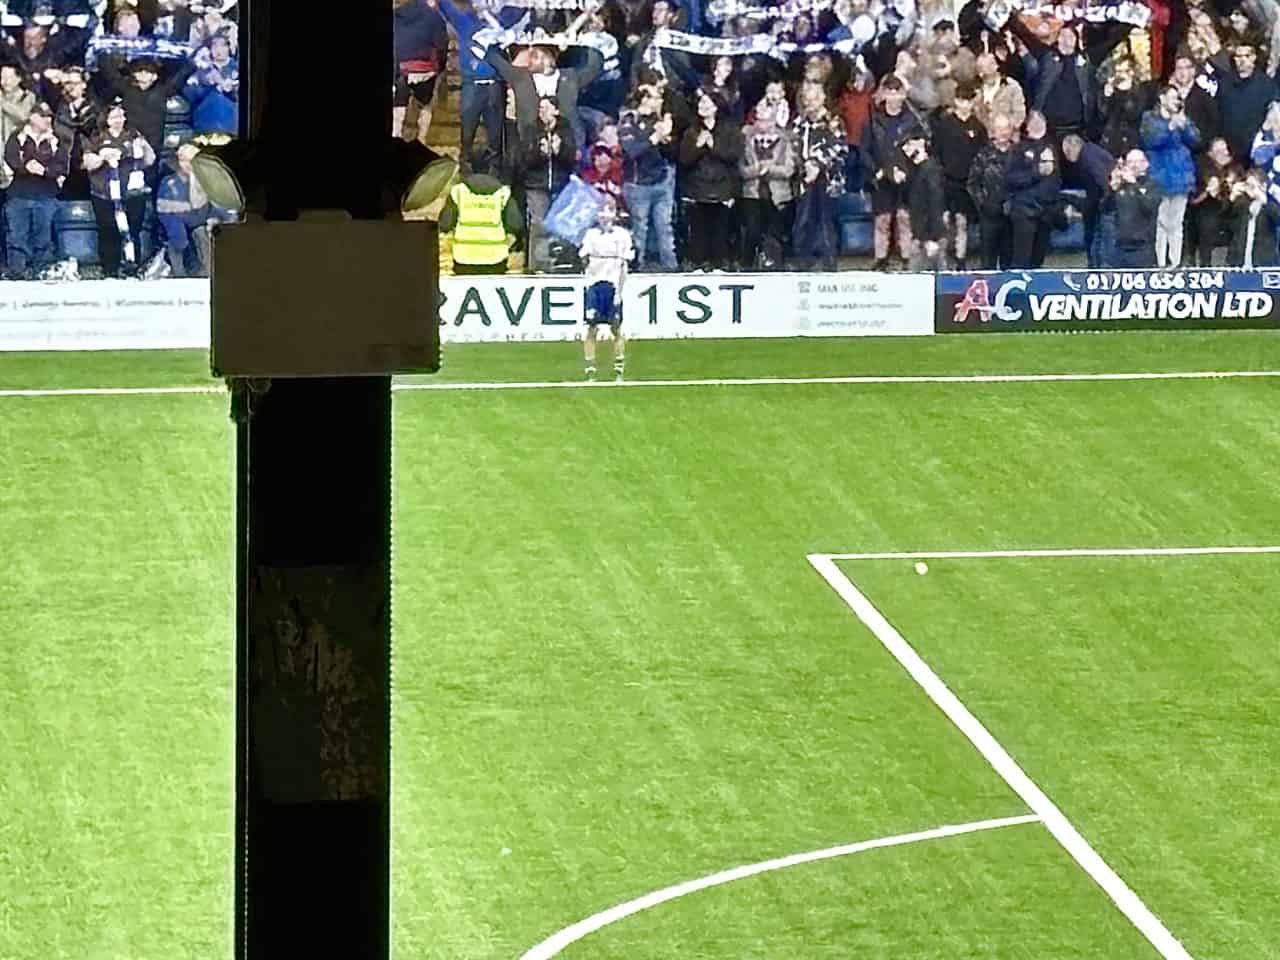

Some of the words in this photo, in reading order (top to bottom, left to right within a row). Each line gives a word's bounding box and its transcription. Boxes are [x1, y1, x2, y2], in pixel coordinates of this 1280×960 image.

[437, 286, 578, 327] AVE
[637, 283, 755, 326] 1ST
[1028, 290, 1219, 322] VENTILATION
[1221, 290, 1274, 320] LTD
